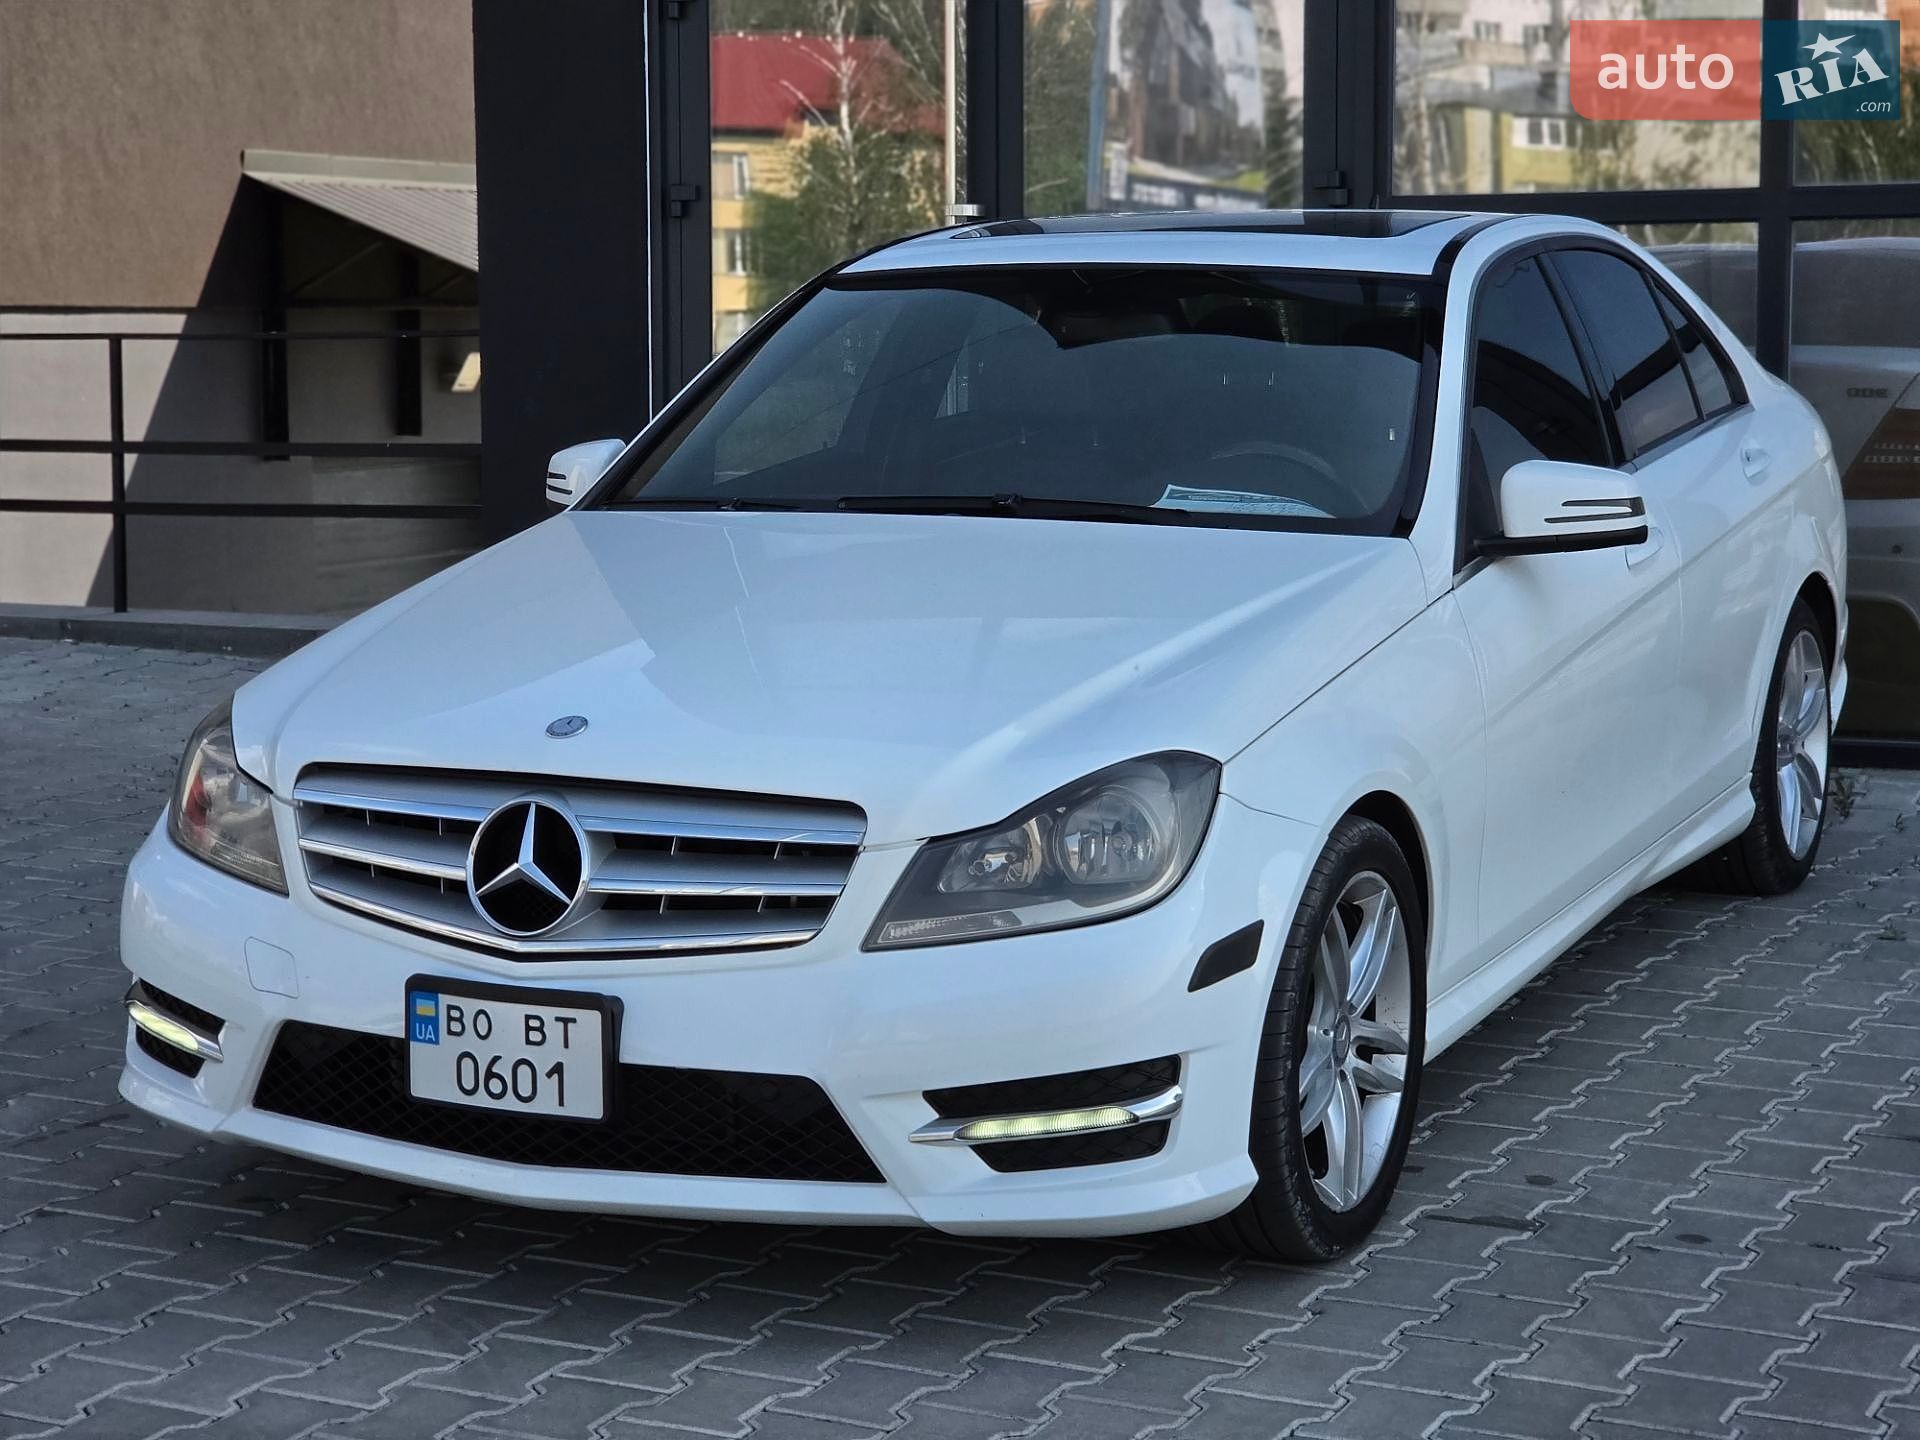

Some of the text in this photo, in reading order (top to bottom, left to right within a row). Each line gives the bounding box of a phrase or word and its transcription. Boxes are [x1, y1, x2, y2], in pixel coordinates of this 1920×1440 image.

[415, 1022, 436, 1042] UA
[524, 1013, 578, 1049] BT
[456, 1050, 564, 1108] 0601
